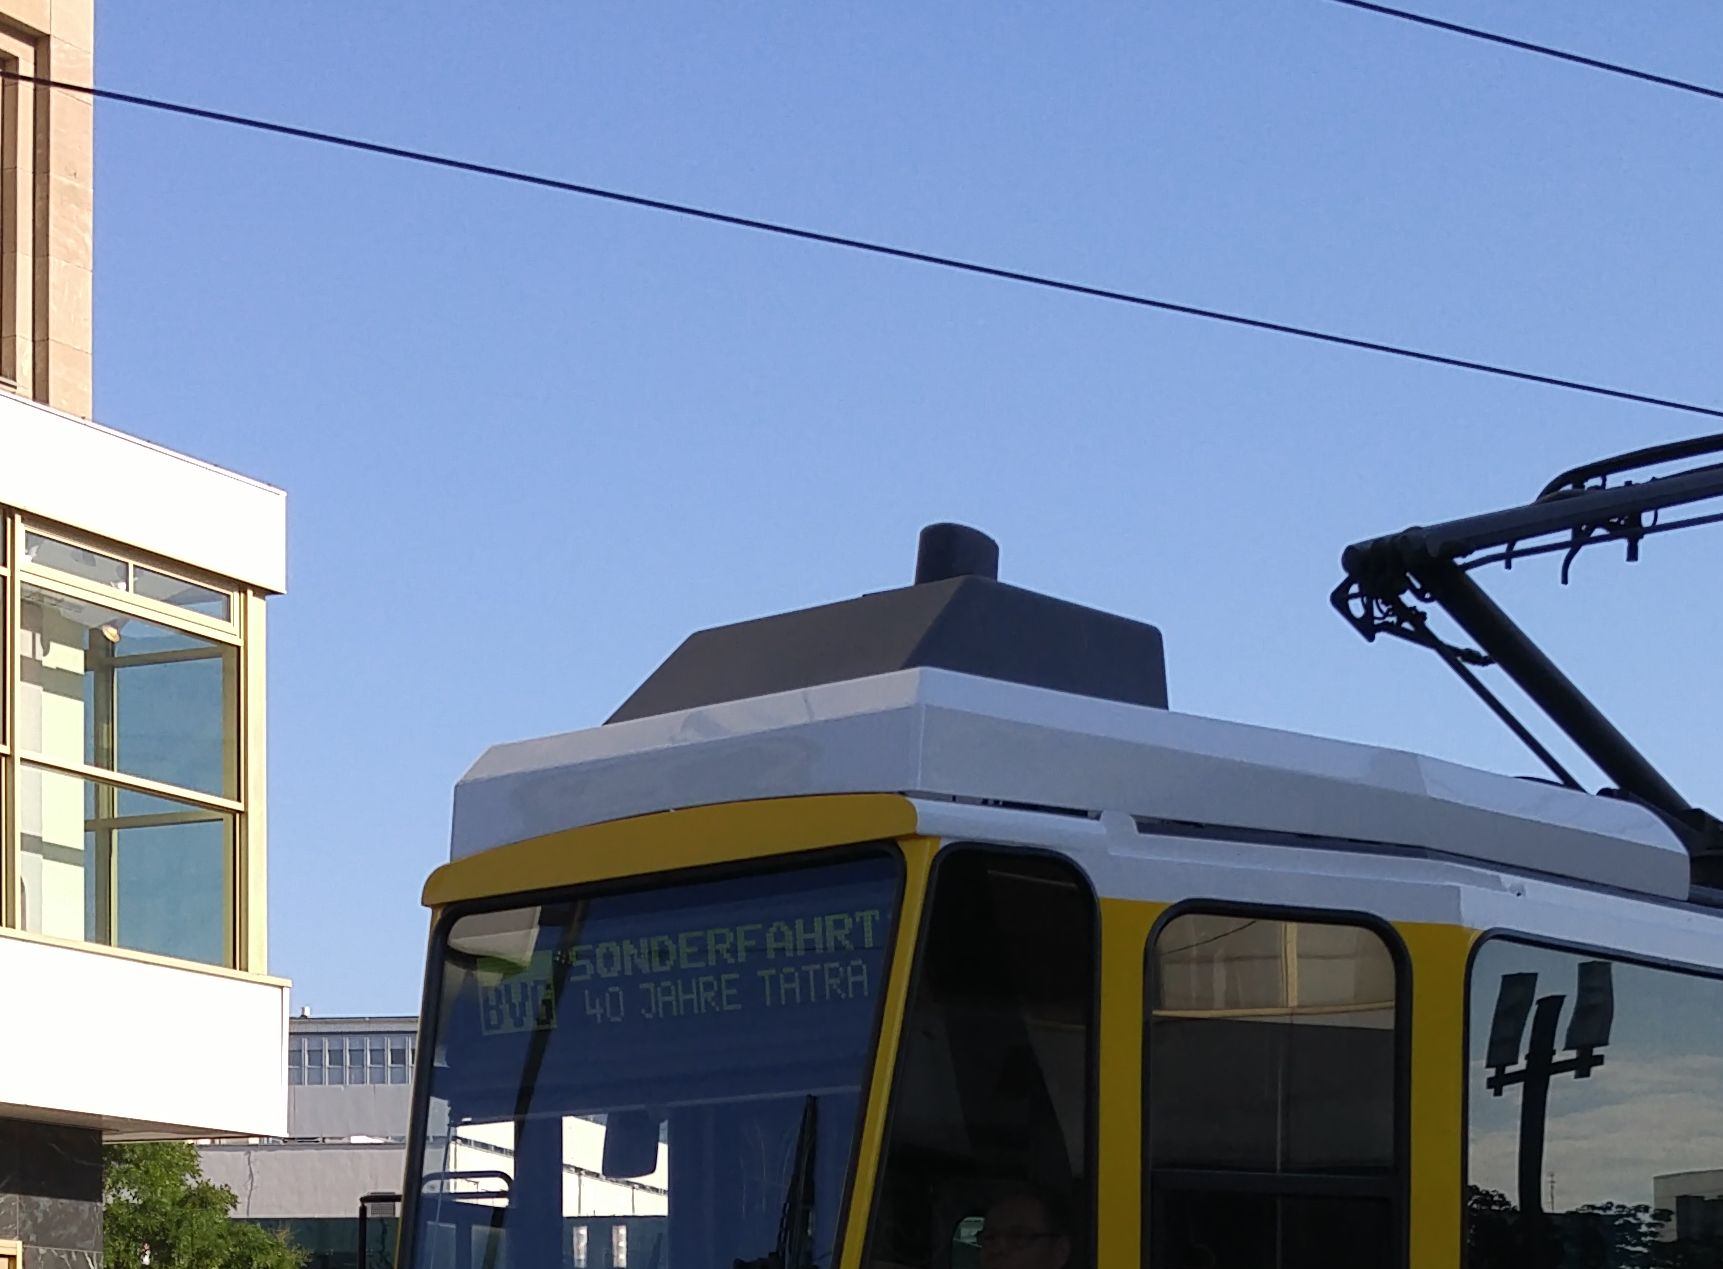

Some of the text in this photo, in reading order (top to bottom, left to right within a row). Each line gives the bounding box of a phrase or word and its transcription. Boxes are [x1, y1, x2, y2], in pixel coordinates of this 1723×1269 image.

[567, 910, 880, 983] SONDERFAHRT
[584, 957, 869, 1024] 40 JAHRE TATRA
